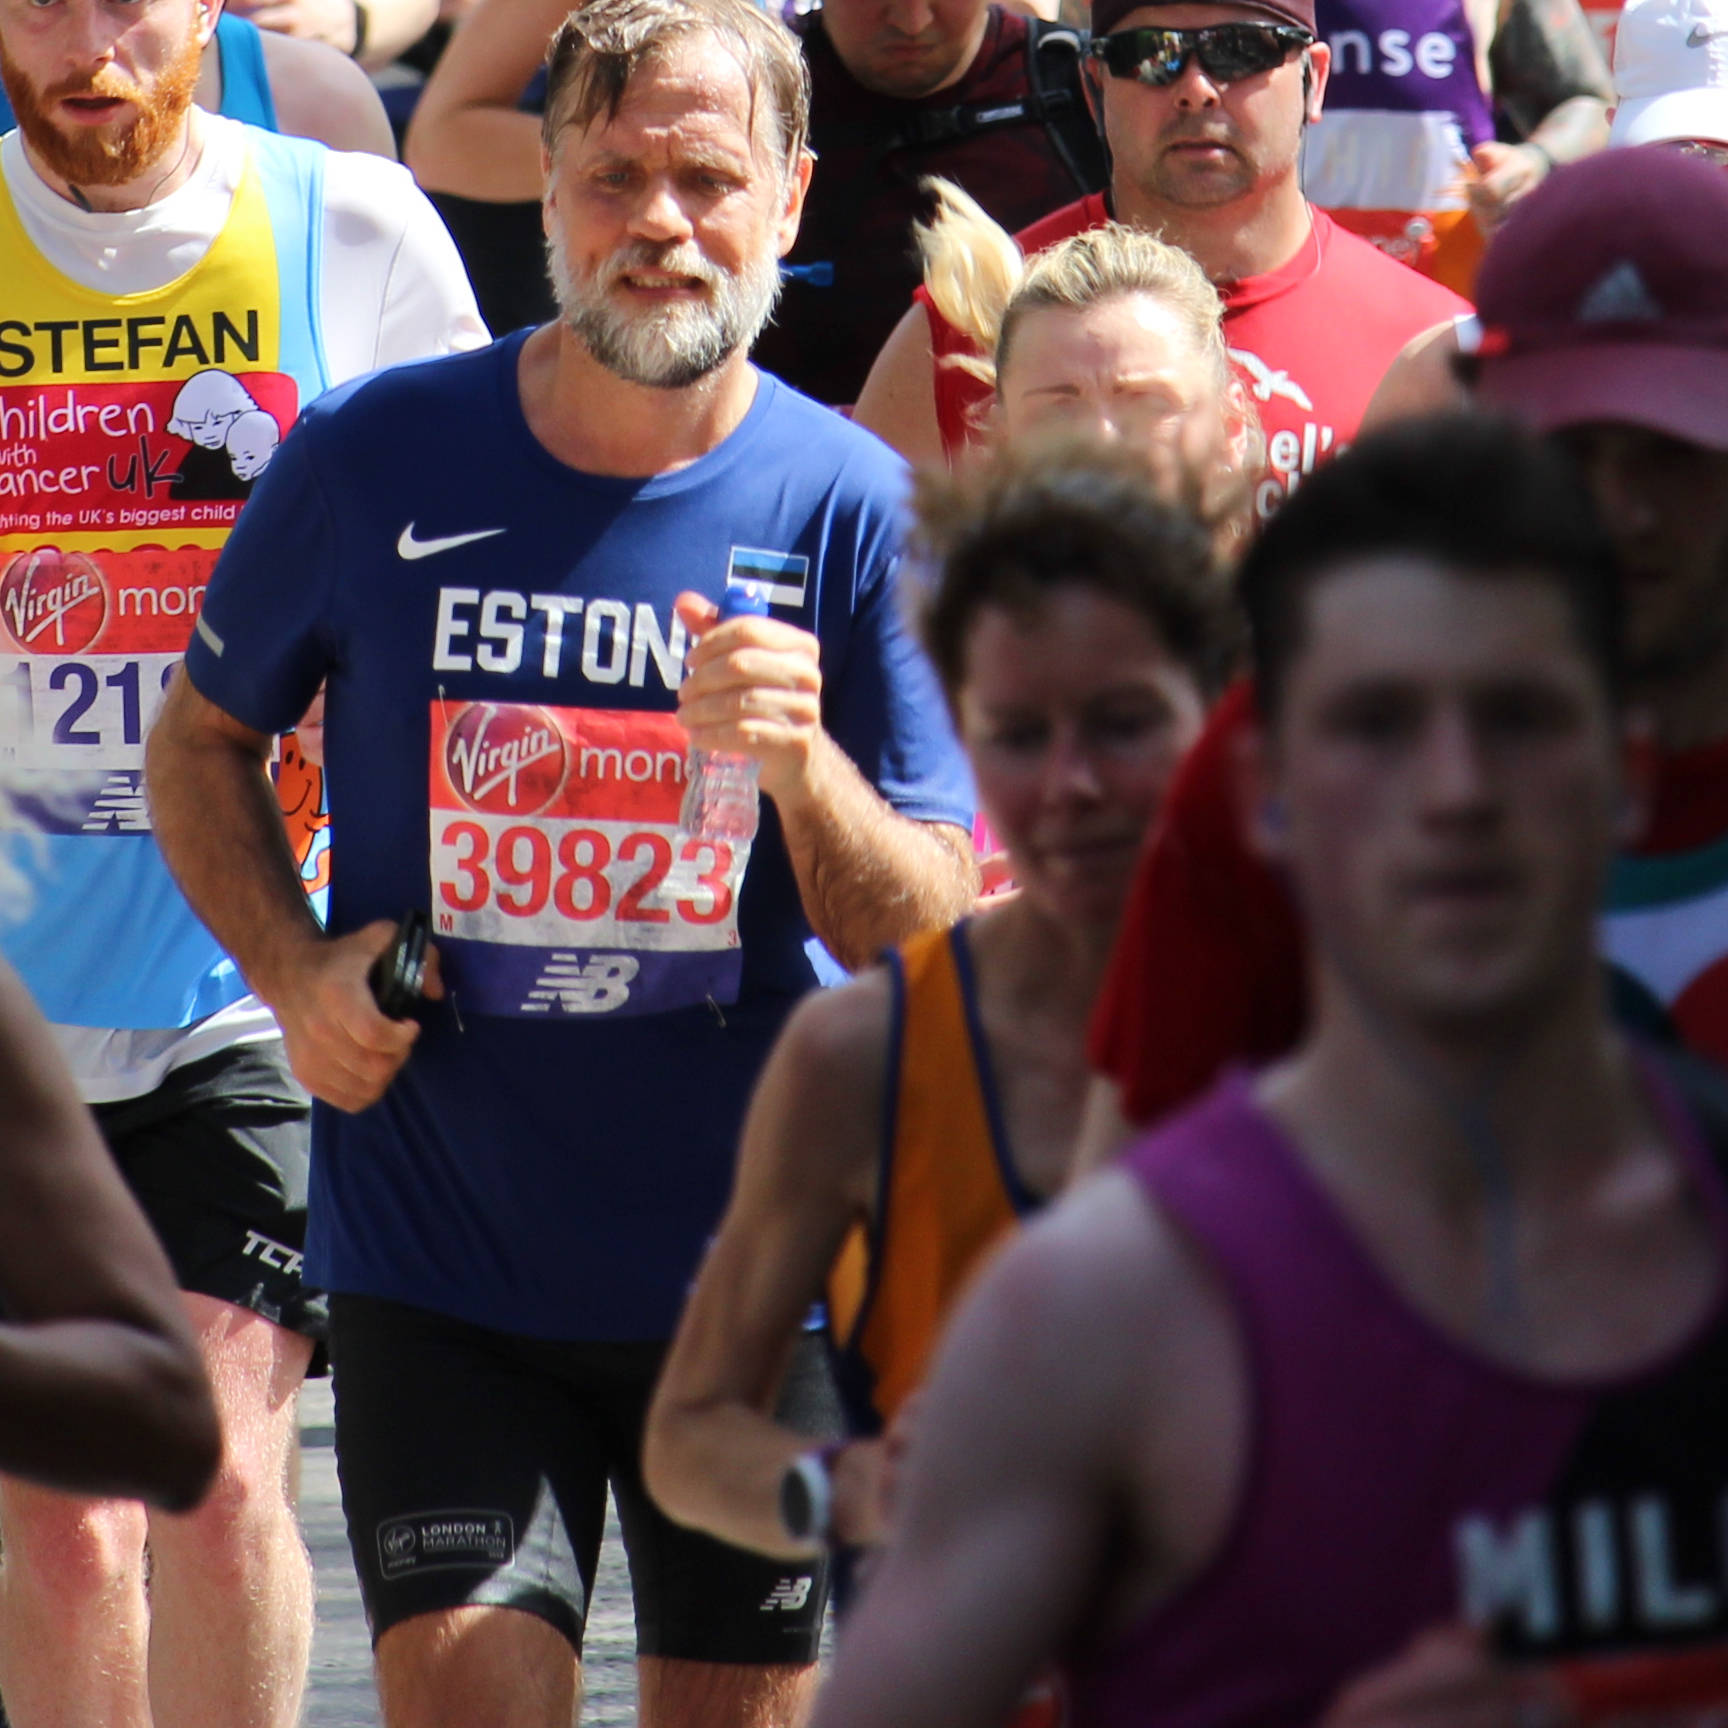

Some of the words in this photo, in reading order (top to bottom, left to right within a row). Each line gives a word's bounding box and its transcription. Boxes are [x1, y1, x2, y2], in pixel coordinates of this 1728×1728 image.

[106, 434, 185, 499] uk
[45, 509, 73, 527] the
[79, 507, 115, 525] UK's
[119, 503, 186, 526] biggest
[191, 503, 235, 522] child
[4, 557, 100, 648] Virgin
[433, 586, 700, 691] ESTON
[6, 660, 188, 746] 121
[452, 706, 560, 807] Virgin
[580, 747, 693, 784] mon
[439, 820, 734, 924] 39823
[440, 913, 453, 933] M
[421, 1522, 486, 1536] LONDON
